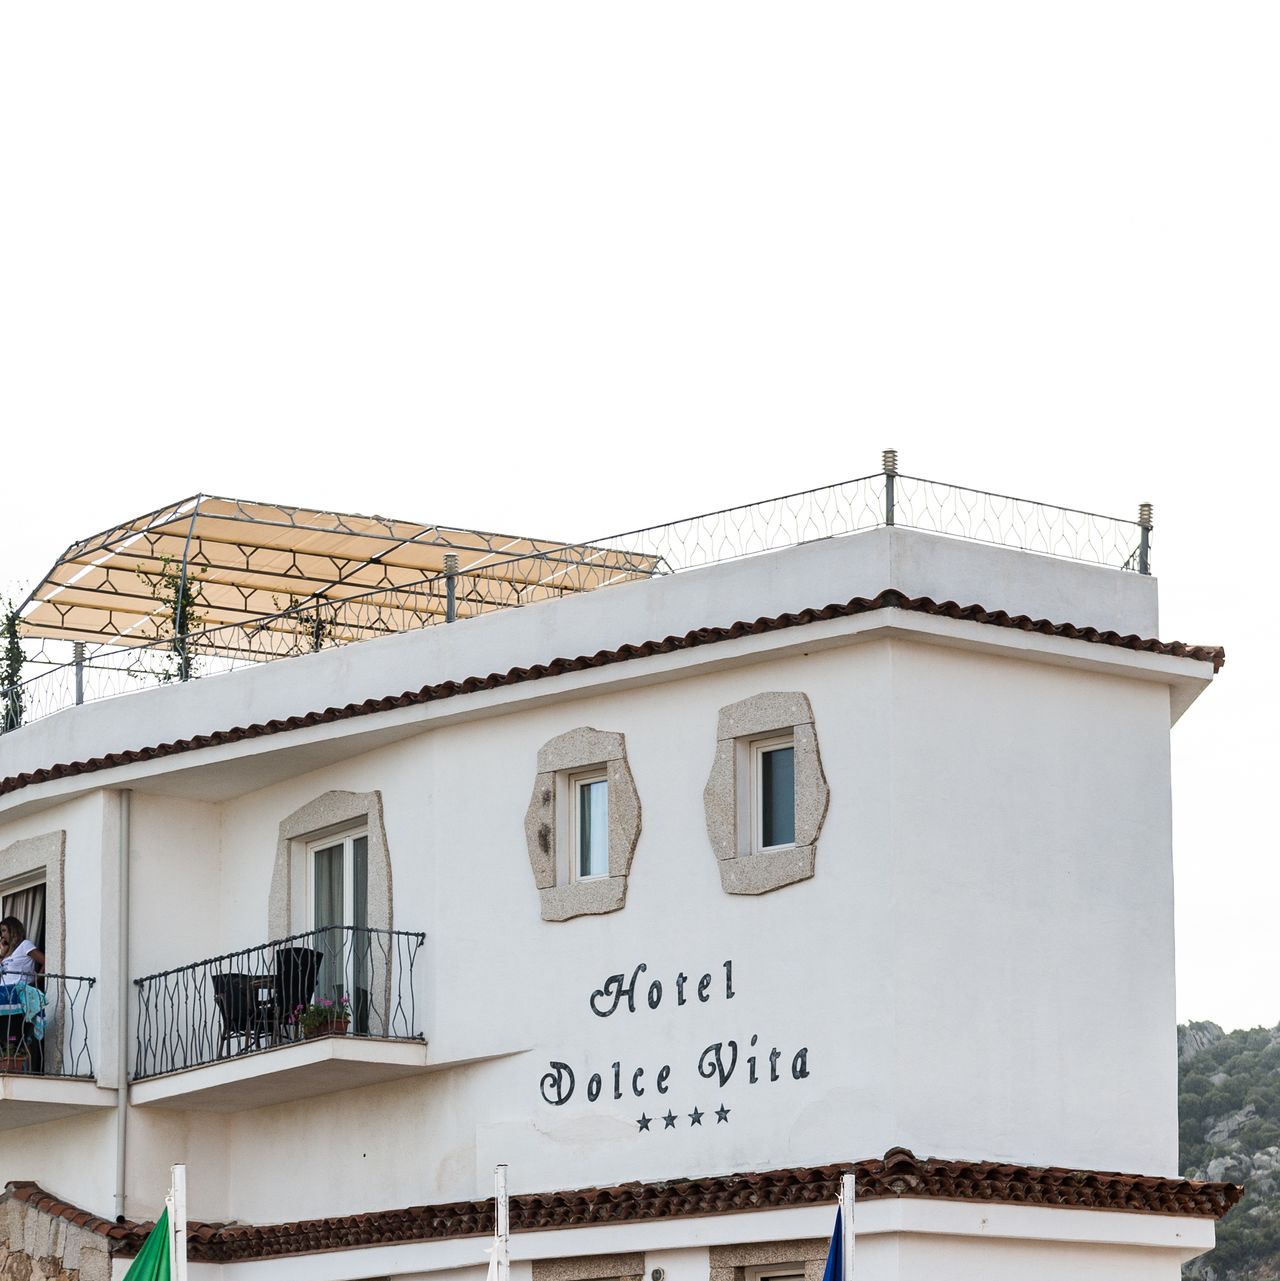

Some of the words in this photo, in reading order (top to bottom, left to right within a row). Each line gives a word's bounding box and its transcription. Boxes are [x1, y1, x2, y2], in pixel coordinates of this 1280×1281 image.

[589, 959, 736, 1018] Hotel
[539, 1061, 671, 1107] Dolce
[697, 1033, 810, 1088] Vita
